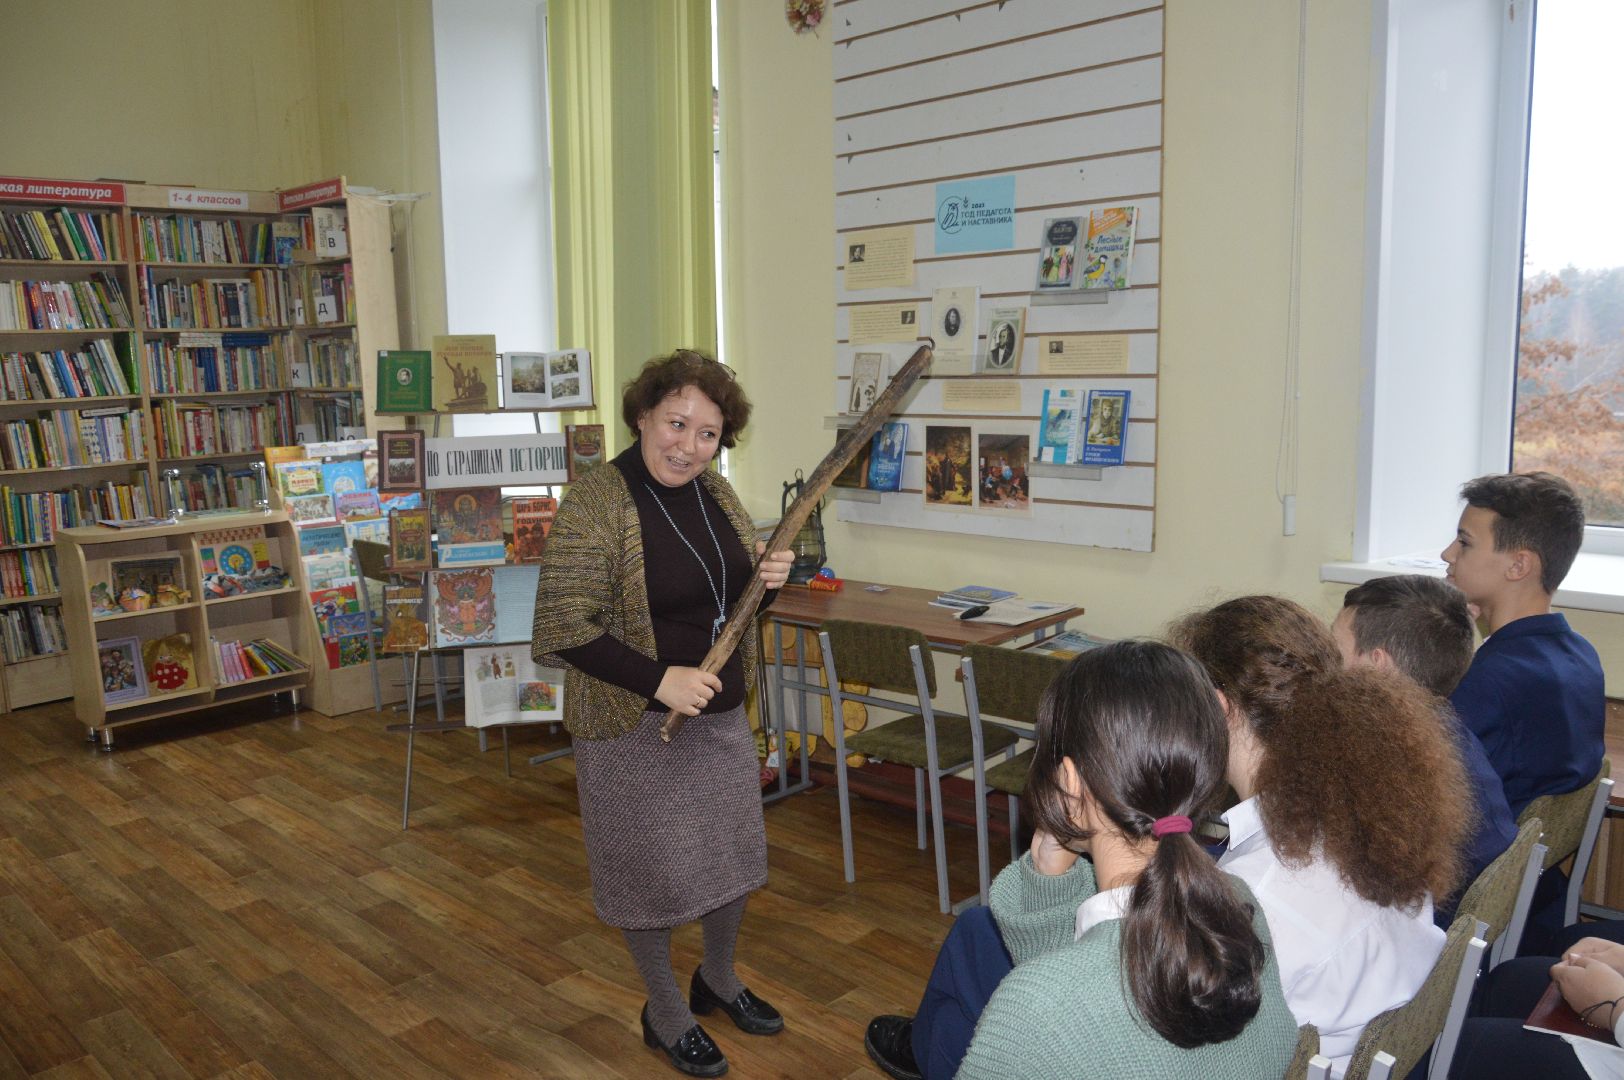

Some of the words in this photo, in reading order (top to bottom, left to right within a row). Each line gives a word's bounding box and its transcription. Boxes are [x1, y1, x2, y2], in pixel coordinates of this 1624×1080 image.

[26, 184, 112, 199] литература
[197, 195, 241, 205] классов
[961, 211, 975, 219] ГОД
[976, 207, 1012, 218] ПЕДАГОГА
[967, 216, 1013, 226] НАСТАВНИКА
[328, 238, 336, 248] В
[318, 303, 328, 316] Д
[292, 369, 300, 379] К
[426, 450, 440, 477] ПО
[446, 448, 504, 476] СТРАНИЦАМ
